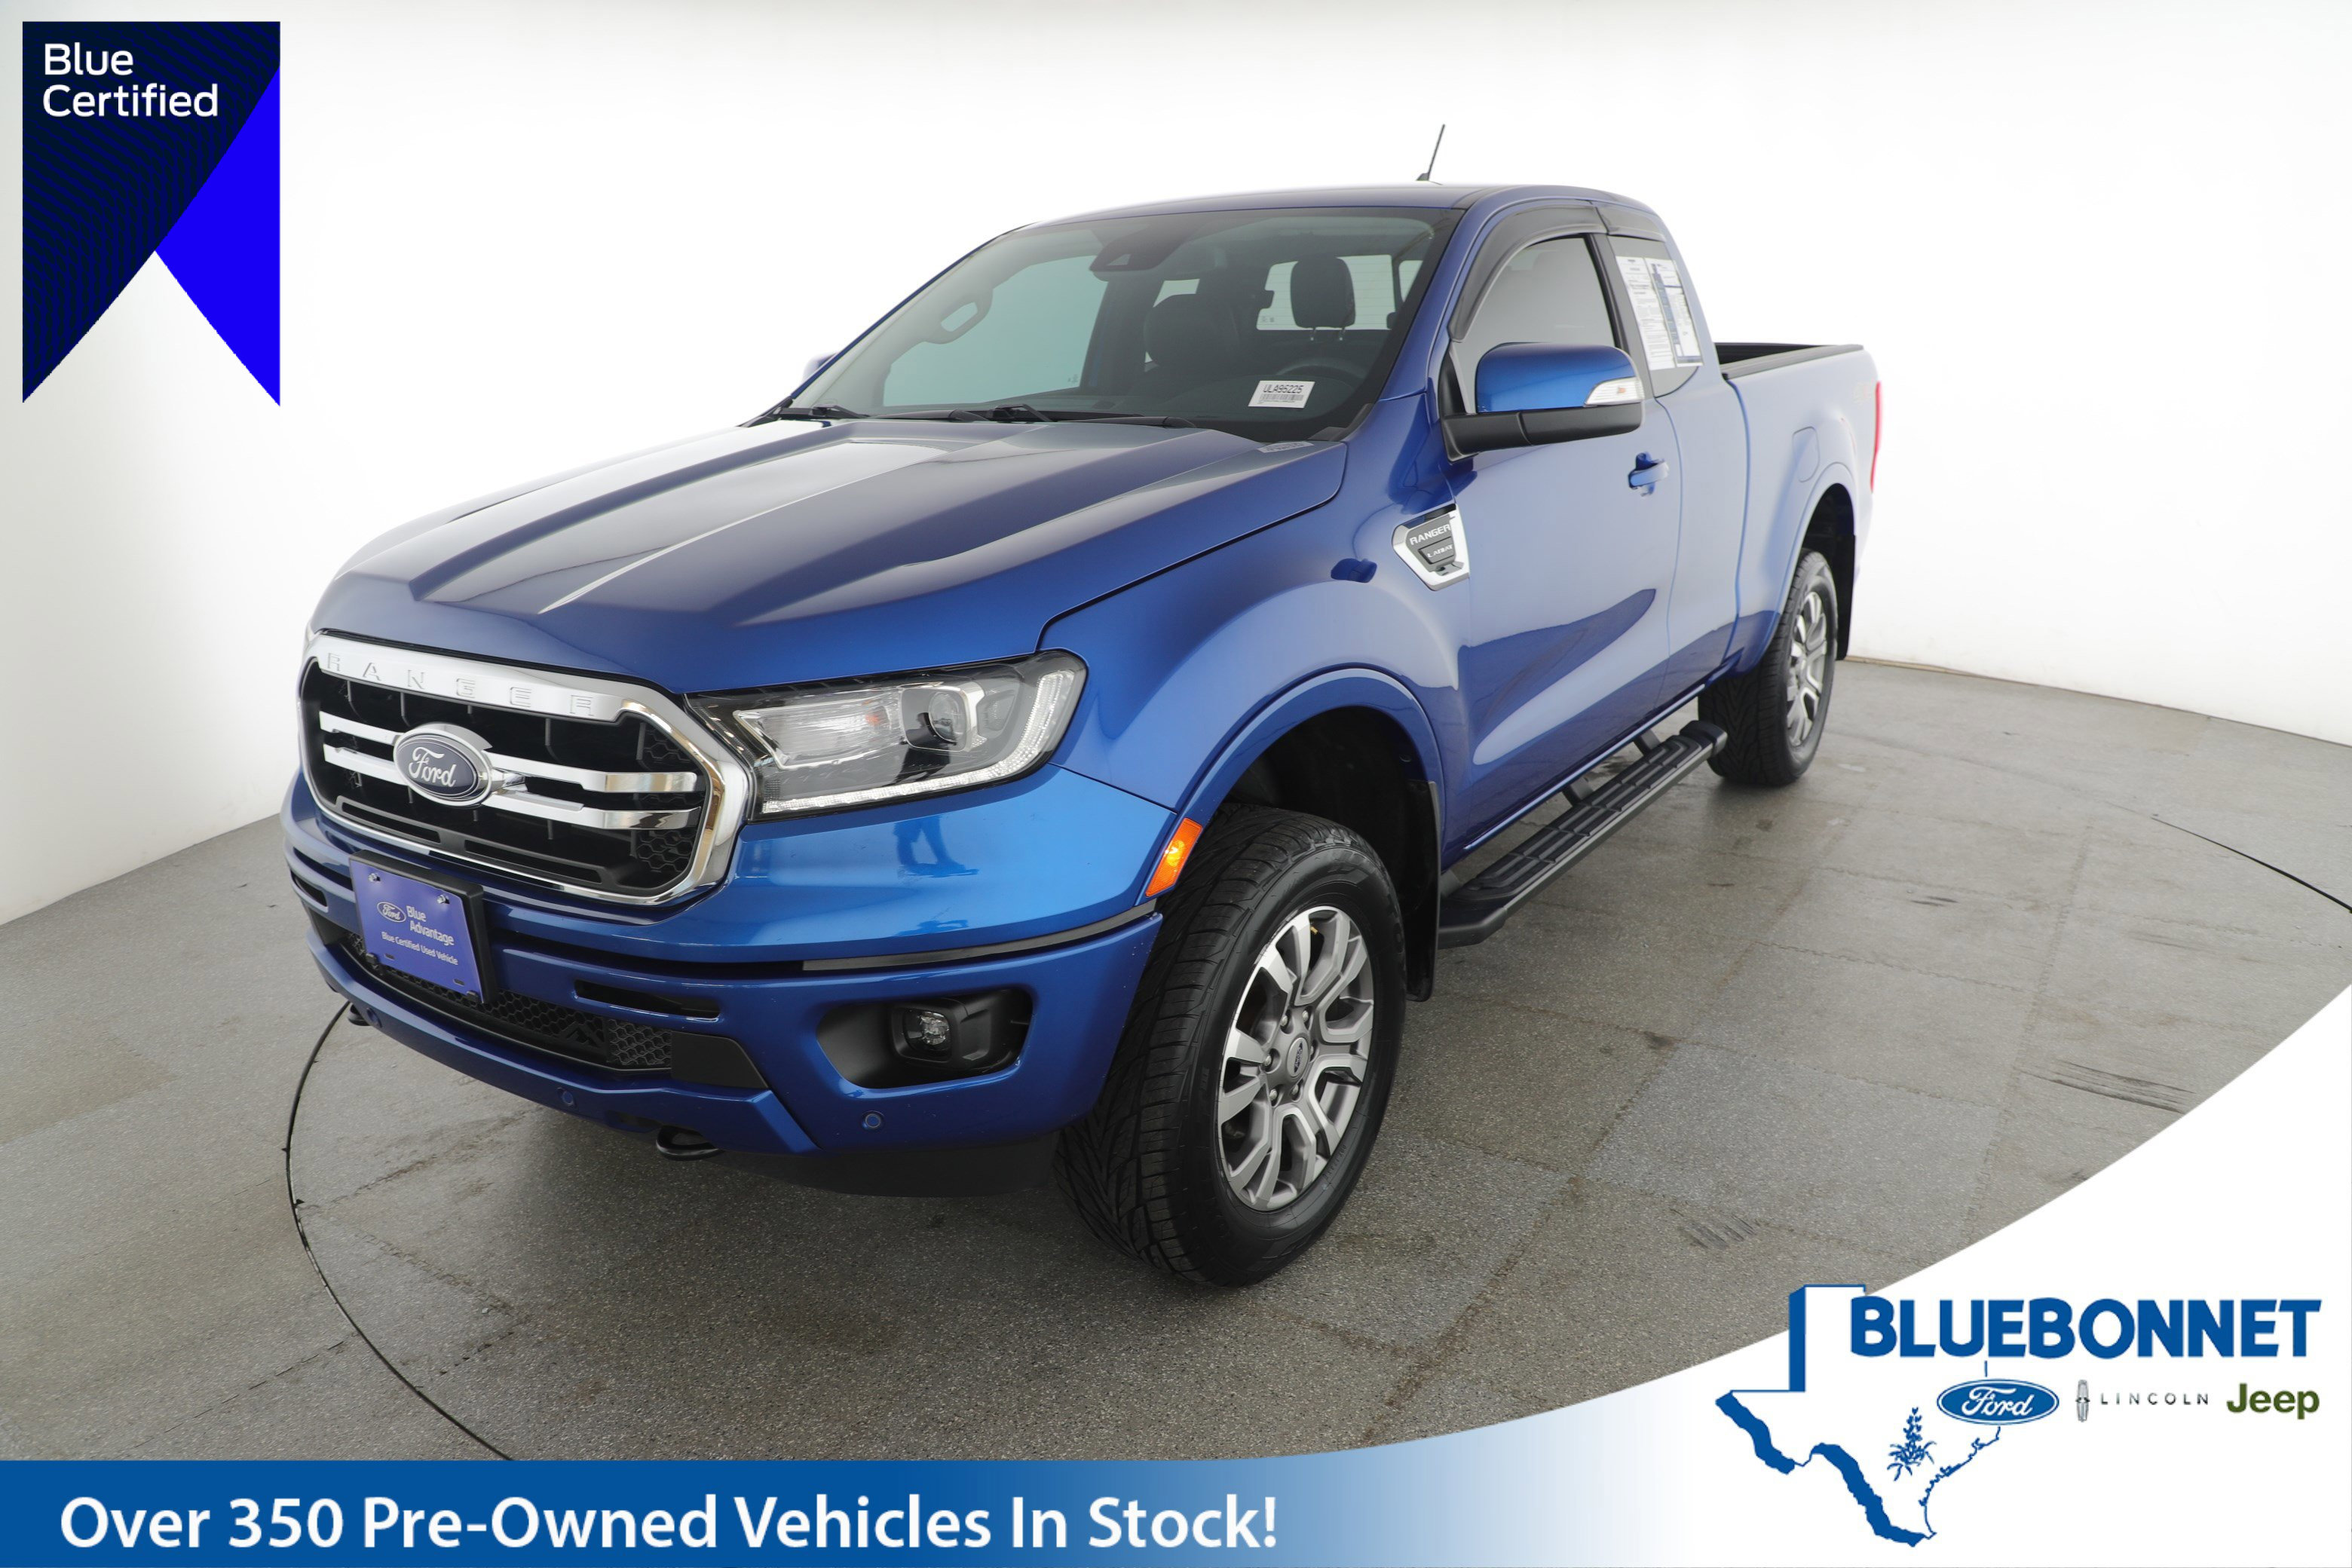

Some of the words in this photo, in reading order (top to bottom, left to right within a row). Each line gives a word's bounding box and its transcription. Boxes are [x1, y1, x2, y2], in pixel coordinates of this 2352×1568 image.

[1409, 524, 1451, 545] RANGER
[326, 652, 595, 716] RANGER
[407, 746, 456, 788] Ford
[383, 903, 401, 920] Ford
[406, 905, 427, 922] Blue
[410, 920, 455, 946] Advantage
[381, 932, 395, 943] Blue
[395, 936, 421, 951] Certified
[421, 945, 436, 957] Used
[436, 950, 458, 965] Vehicle
